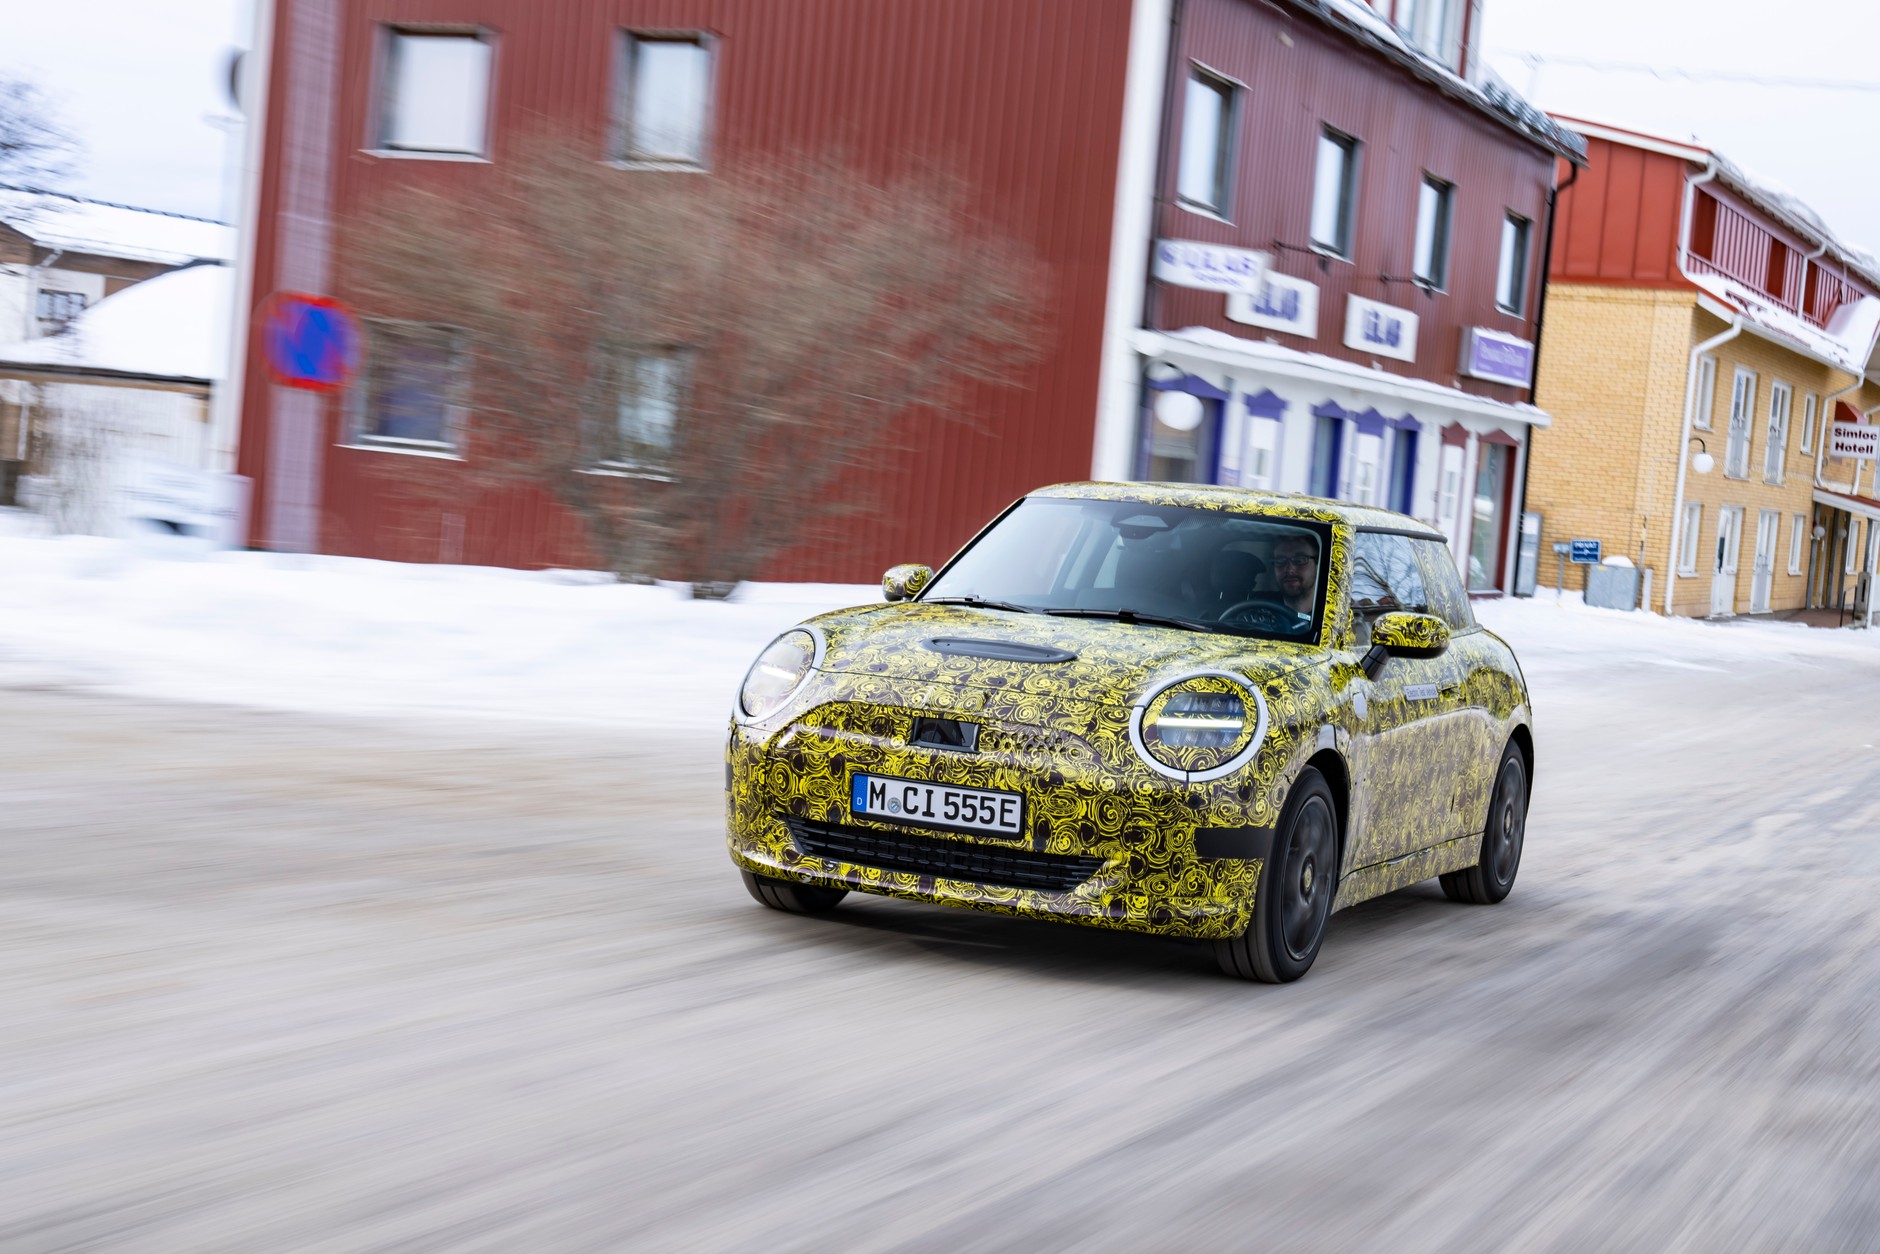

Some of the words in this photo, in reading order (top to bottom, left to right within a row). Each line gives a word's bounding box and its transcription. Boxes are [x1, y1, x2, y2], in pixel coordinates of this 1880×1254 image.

[1834, 427, 1877, 440] Simloc
[1835, 442, 1873, 454] Hotell
[857, 797, 863, 806] D
[869, 781, 886, 810] M
[902, 786, 935, 818] CI
[943, 791, 1017, 828] 555E
